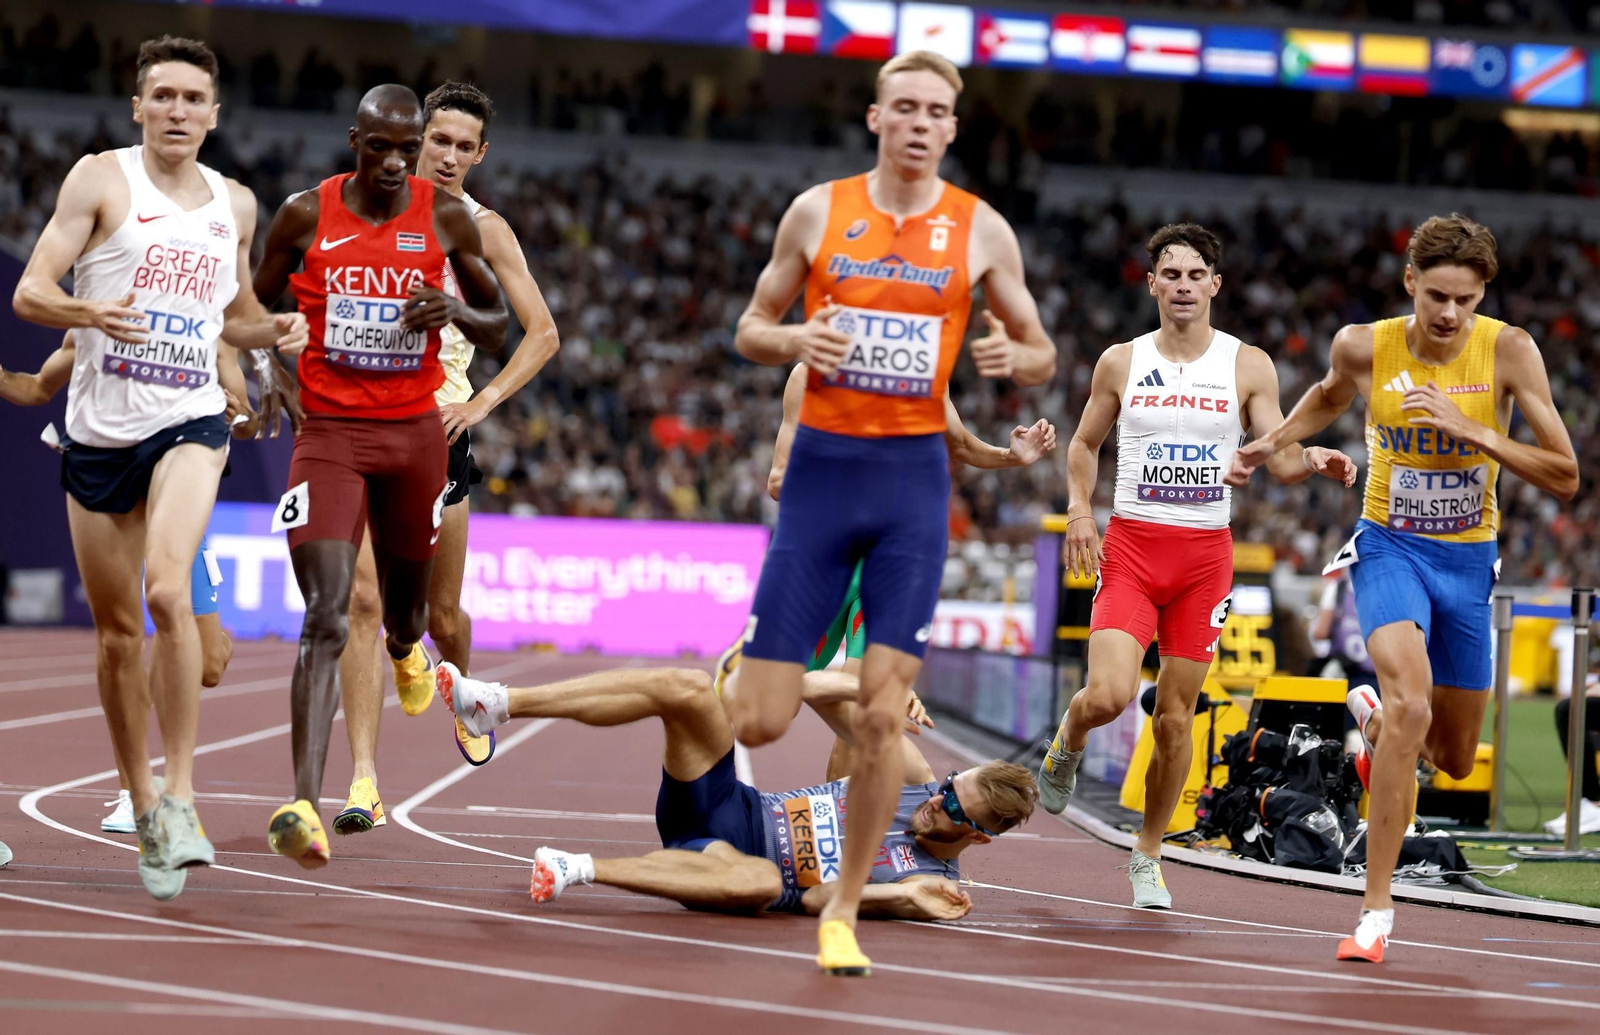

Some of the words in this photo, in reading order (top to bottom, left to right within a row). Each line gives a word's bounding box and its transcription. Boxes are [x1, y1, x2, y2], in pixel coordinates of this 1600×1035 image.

[146, 244, 221, 279] GREAT
[827, 253, 955, 291] Nederland
[133, 267, 218, 304] BRITAIN
[325, 266, 425, 295] KENYA
[145, 310, 206, 340] TDK
[357, 301, 402, 323] TD
[330, 324, 339, 345] T.
[343, 325, 422, 350] CHERUIYOT
[858, 314, 930, 343] TDK
[113, 339, 208, 369] WIGHTMAN
[846, 345, 930, 374] AROS
[1130, 395, 1229, 413] FRANCE
[1446, 385, 1489, 394] BAUHAUS
[1162, 444, 1218, 462] TDK
[1377, 424, 1480, 457] SWEDE
[1143, 465, 1221, 485] MORNET
[1419, 467, 1481, 490] TDK
[281, 494, 299, 523] 8
[1394, 493, 1482, 517] PIHLSTRÖM
[1218, 598, 1232, 624] 3
[790, 808, 818, 872] KERR
[816, 816, 840, 879] TDK
